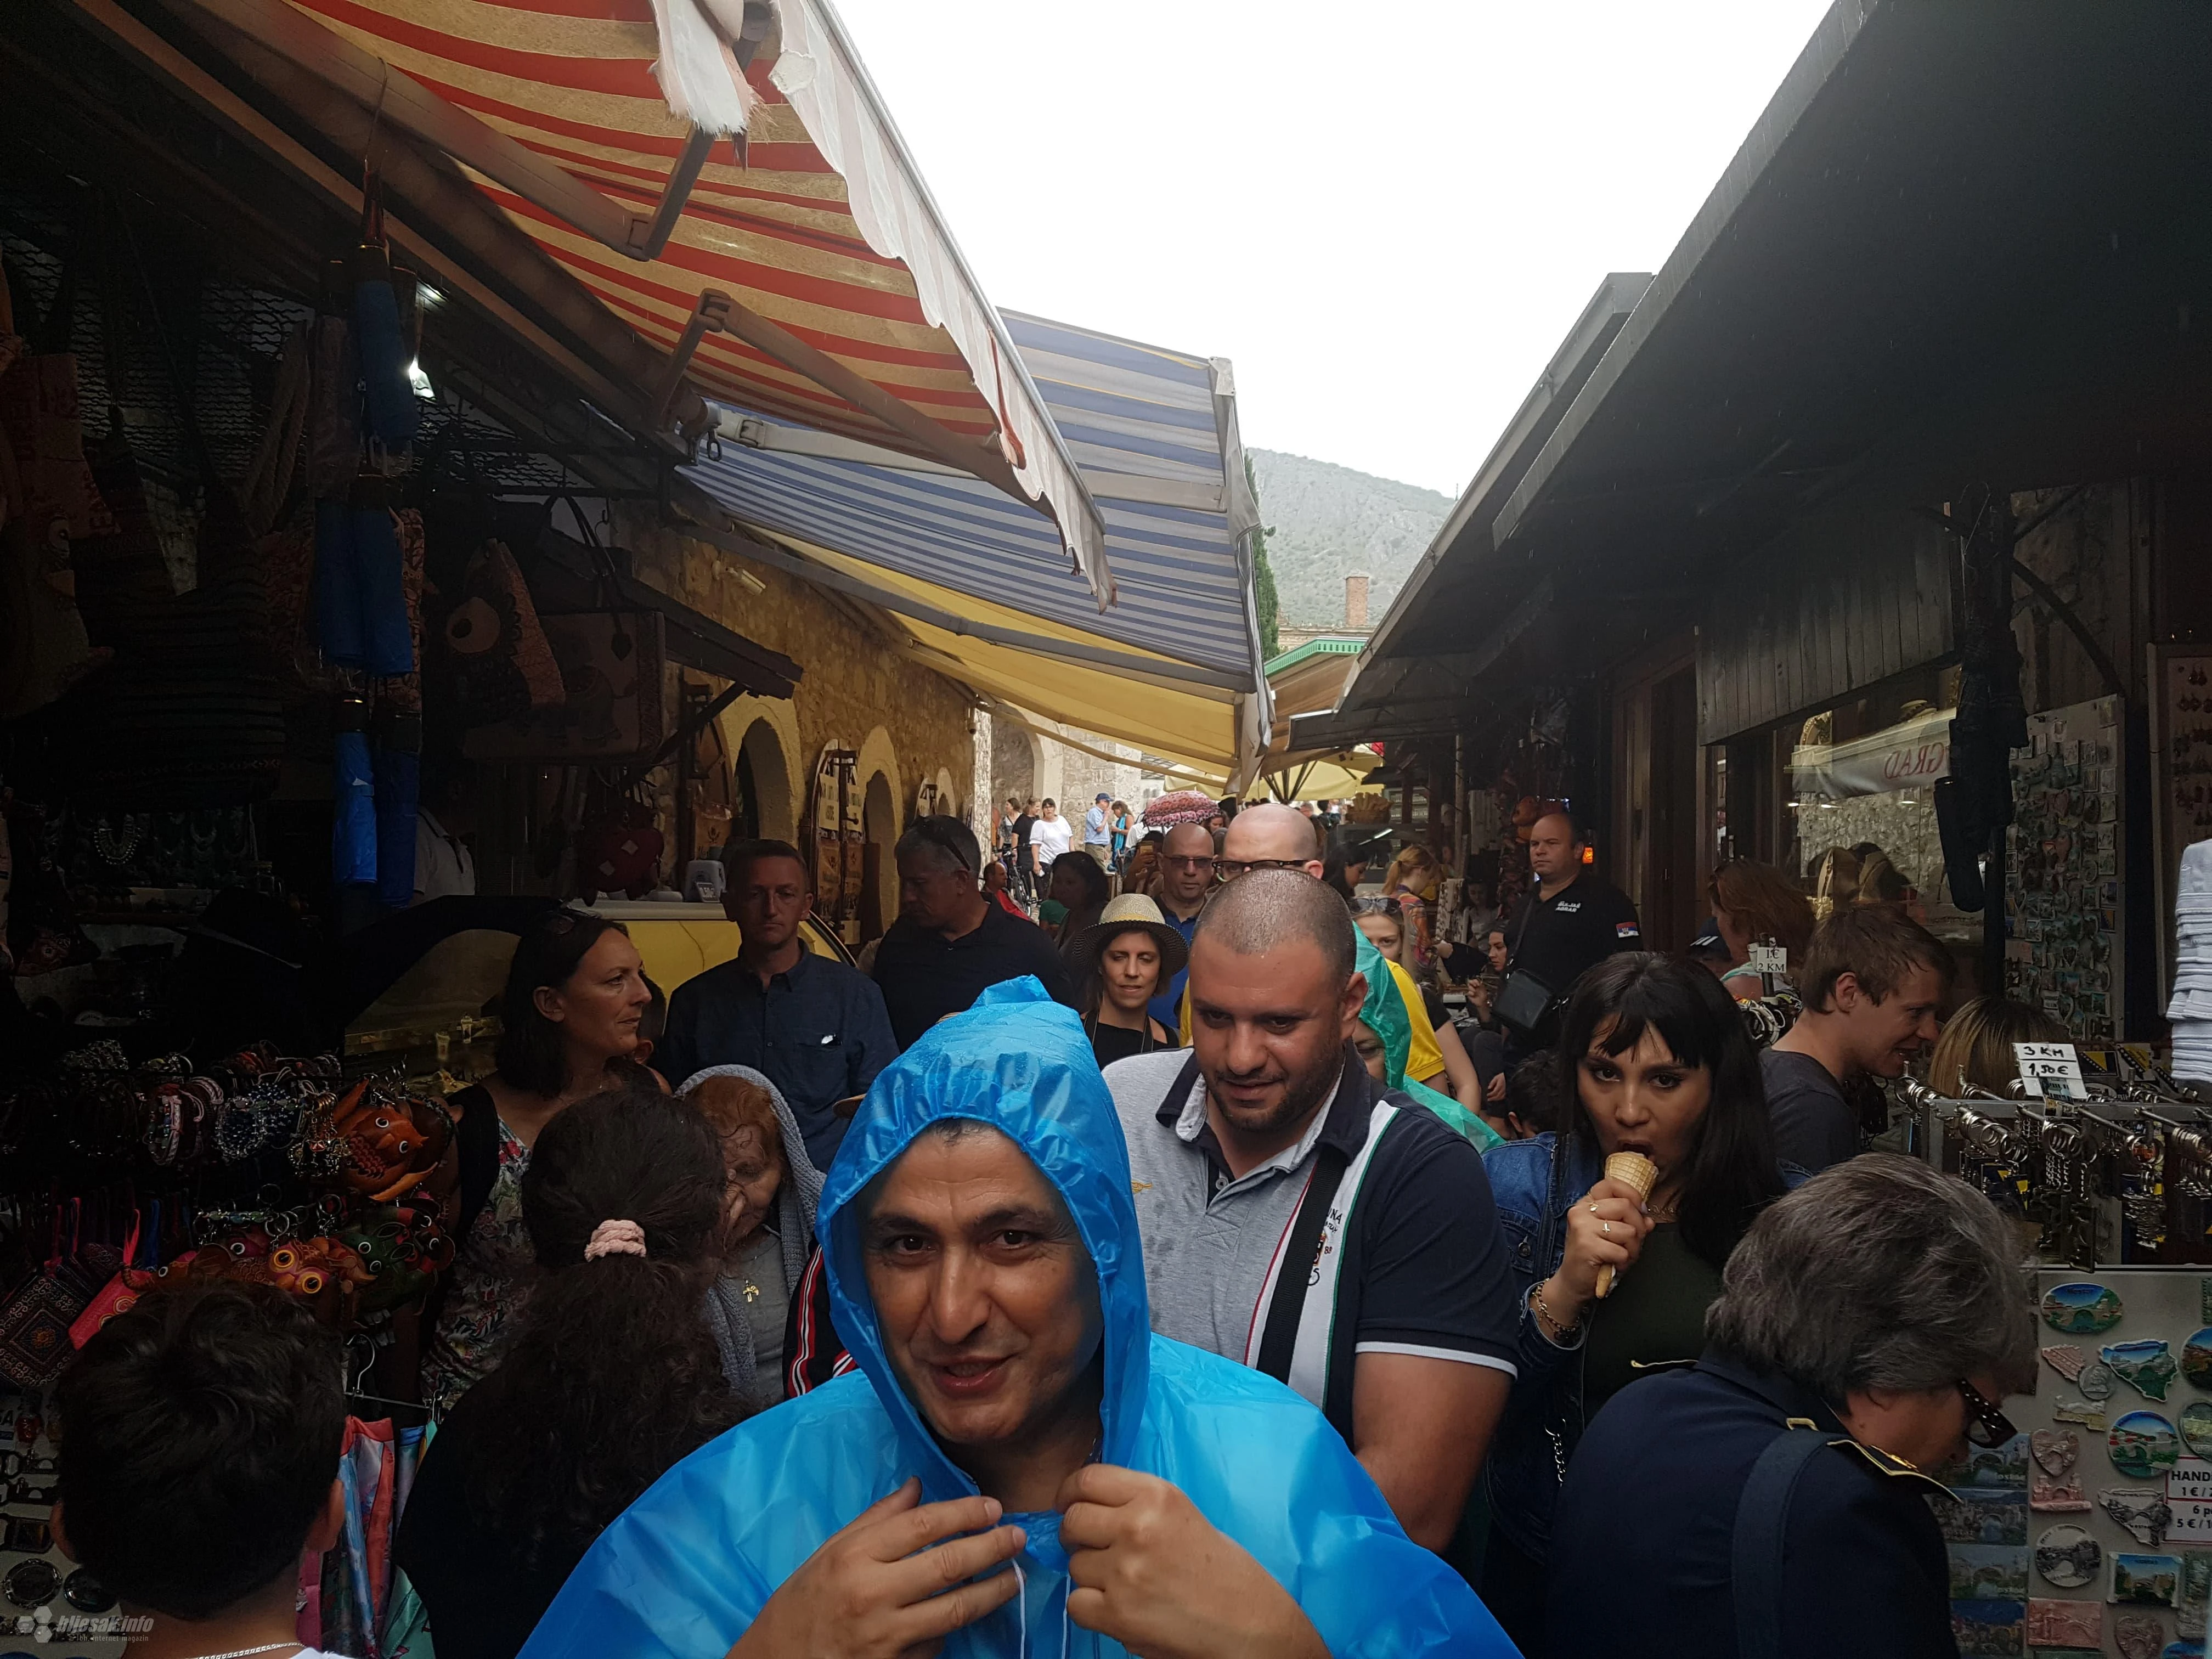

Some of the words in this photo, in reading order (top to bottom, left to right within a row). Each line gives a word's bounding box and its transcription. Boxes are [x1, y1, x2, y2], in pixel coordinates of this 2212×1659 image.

[1767, 963, 1785, 972] KM
[2023, 1046, 2035, 1056] 3
[2040, 1046, 2064, 1058] KM
[2193, 1505, 2199, 1514] 6
